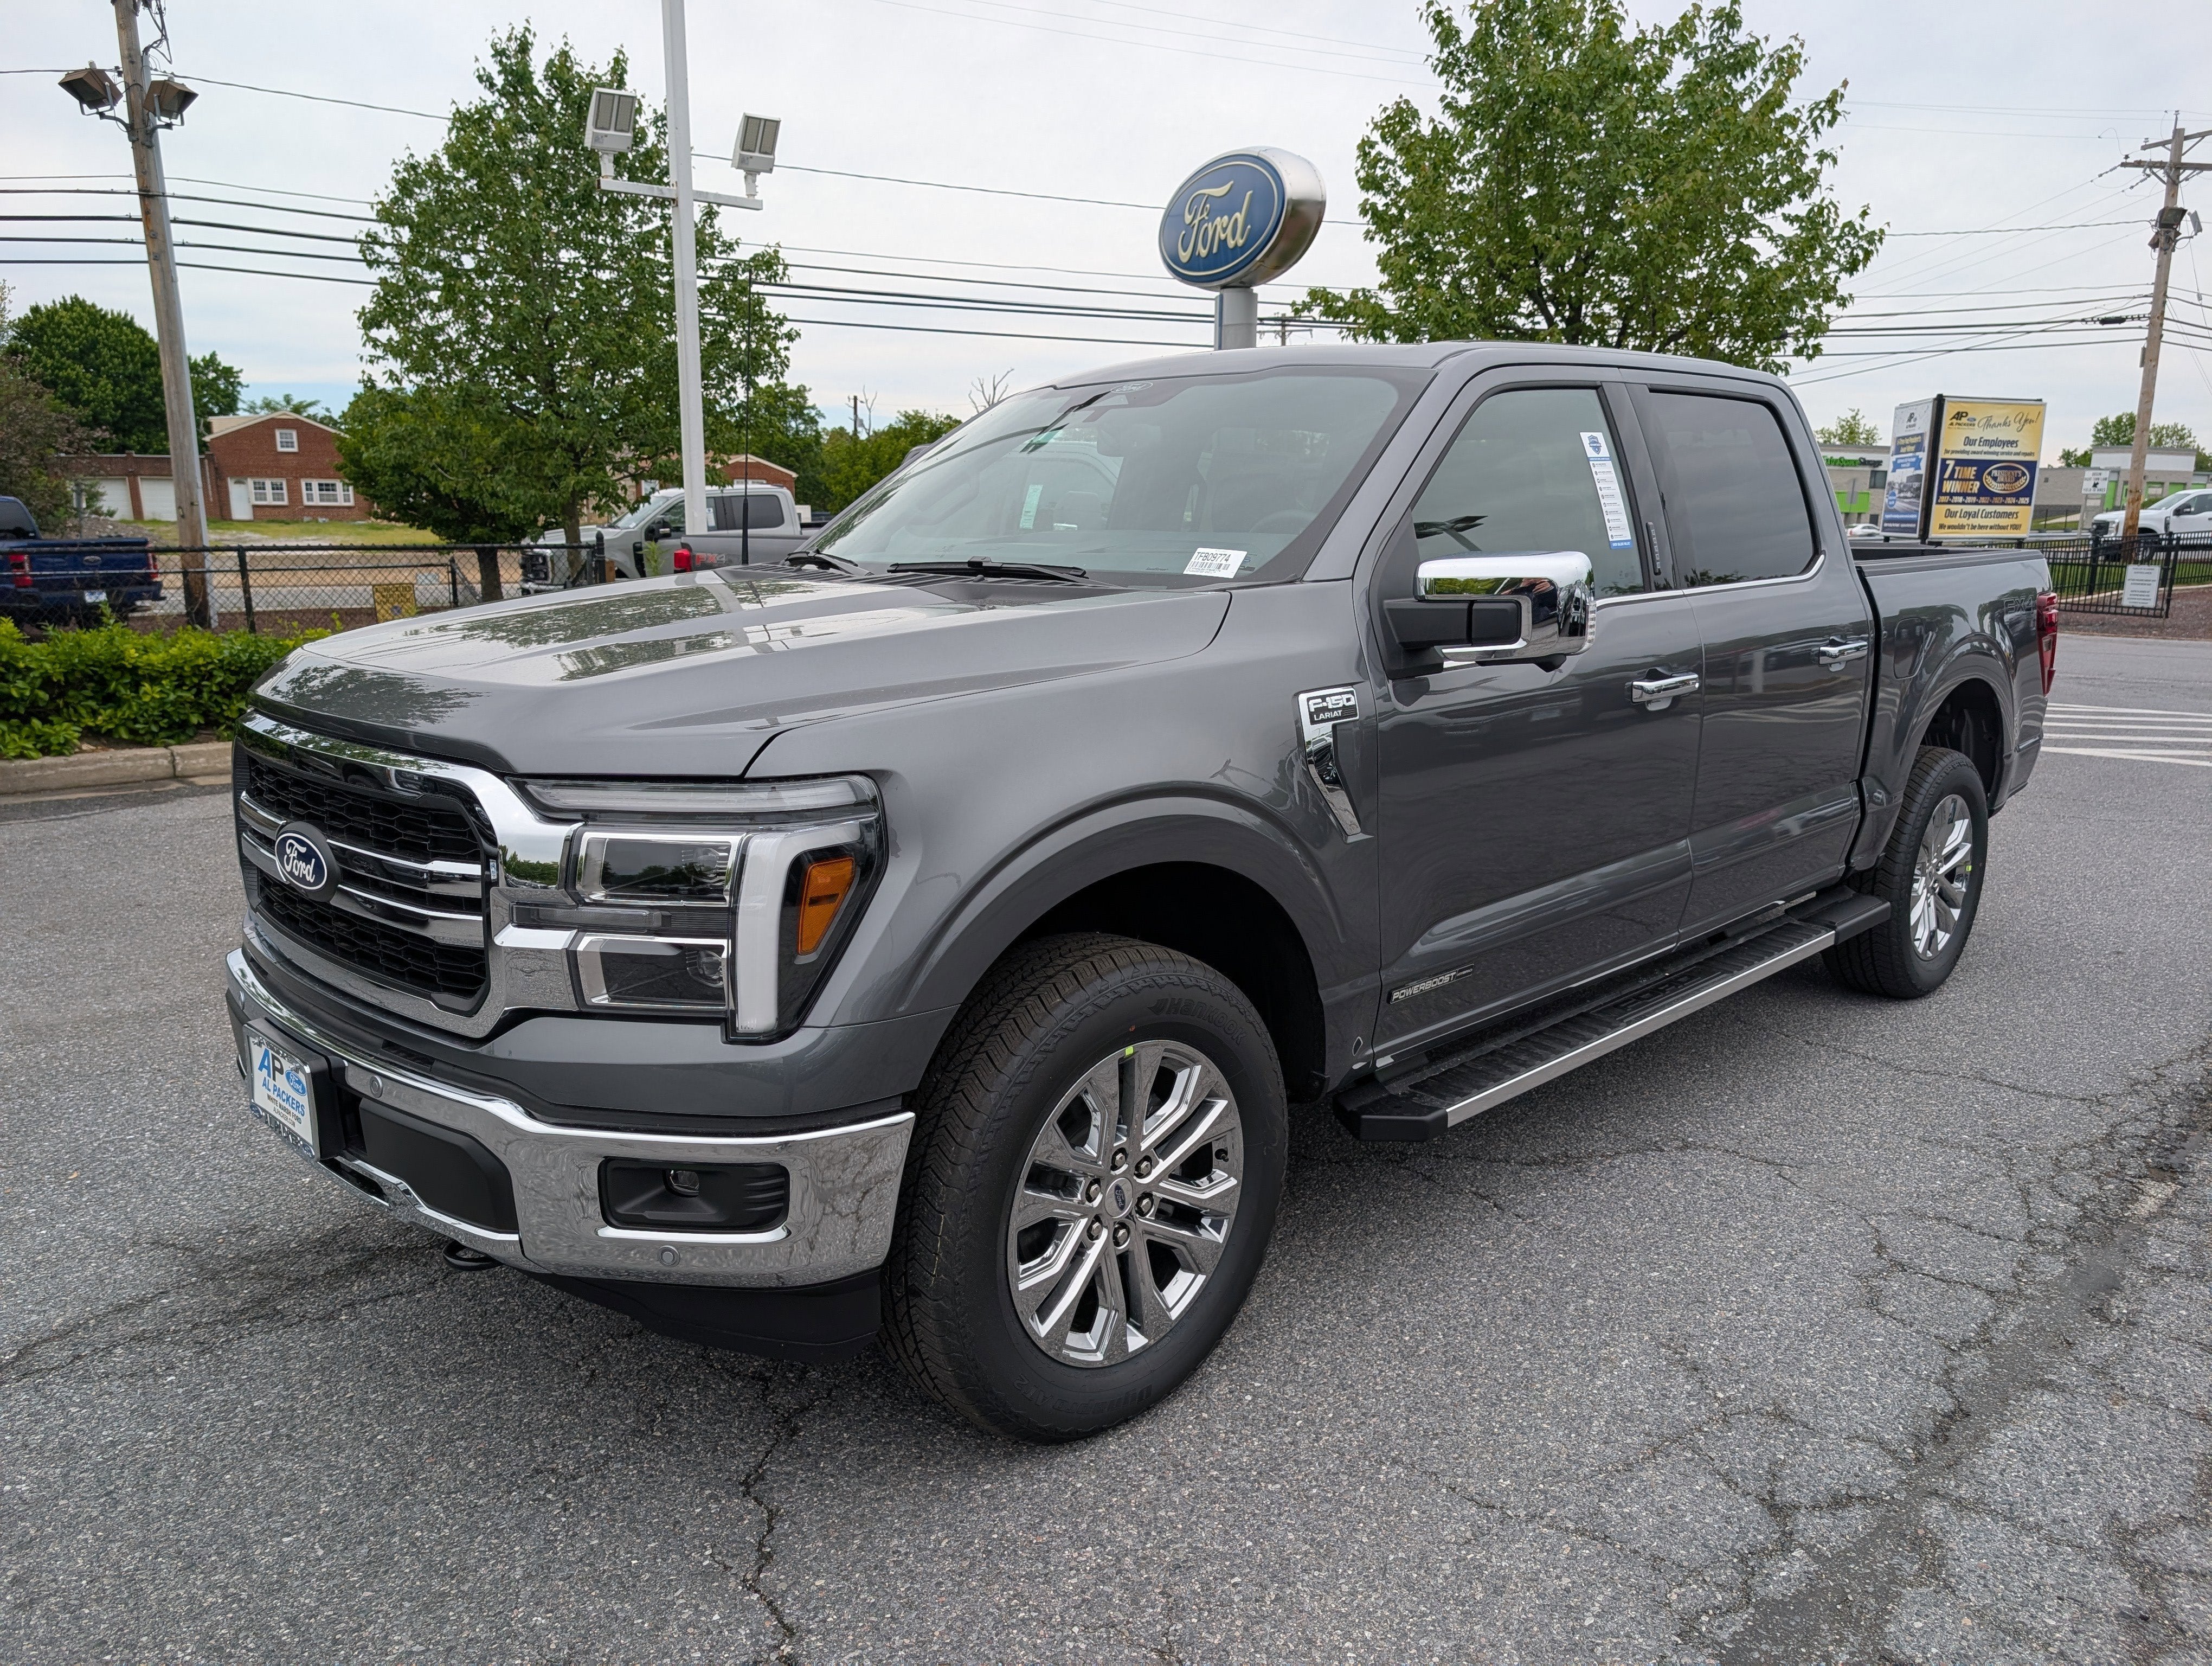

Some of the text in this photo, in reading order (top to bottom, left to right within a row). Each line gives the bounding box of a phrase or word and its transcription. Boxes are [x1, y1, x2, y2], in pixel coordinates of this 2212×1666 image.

[1178, 180, 1253, 263] Ford
[1950, 411, 1968, 421] AP
[1977, 415, 2011, 432] Thanks
[1963, 436, 2019, 449] Our Employees
[1943, 460, 1977, 479] 7 TIME
[1942, 480, 1980, 494] WINNER
[1944, 508, 2019, 520] Our Loyal Customers
[696, 553, 725, 566] FX4
[1194, 552, 1231, 562] TFB09774
[2002, 595, 2034, 614] FX4
[1308, 693, 1355, 712] F-150
[1314, 709, 1343, 721] LARIAT
[284, 839, 315, 883] Ford
[1392, 971, 1457, 1002] POWERBOOST
[258, 1047, 284, 1082] AP
[289, 1073, 303, 1093] Ford
[262, 1076, 271, 1092] AL
[273, 1083, 305, 1117] PACKERS
[267, 1093, 301, 1124] WHITE MARSH FORD
[1115, 1189, 1124, 1207] Ford
